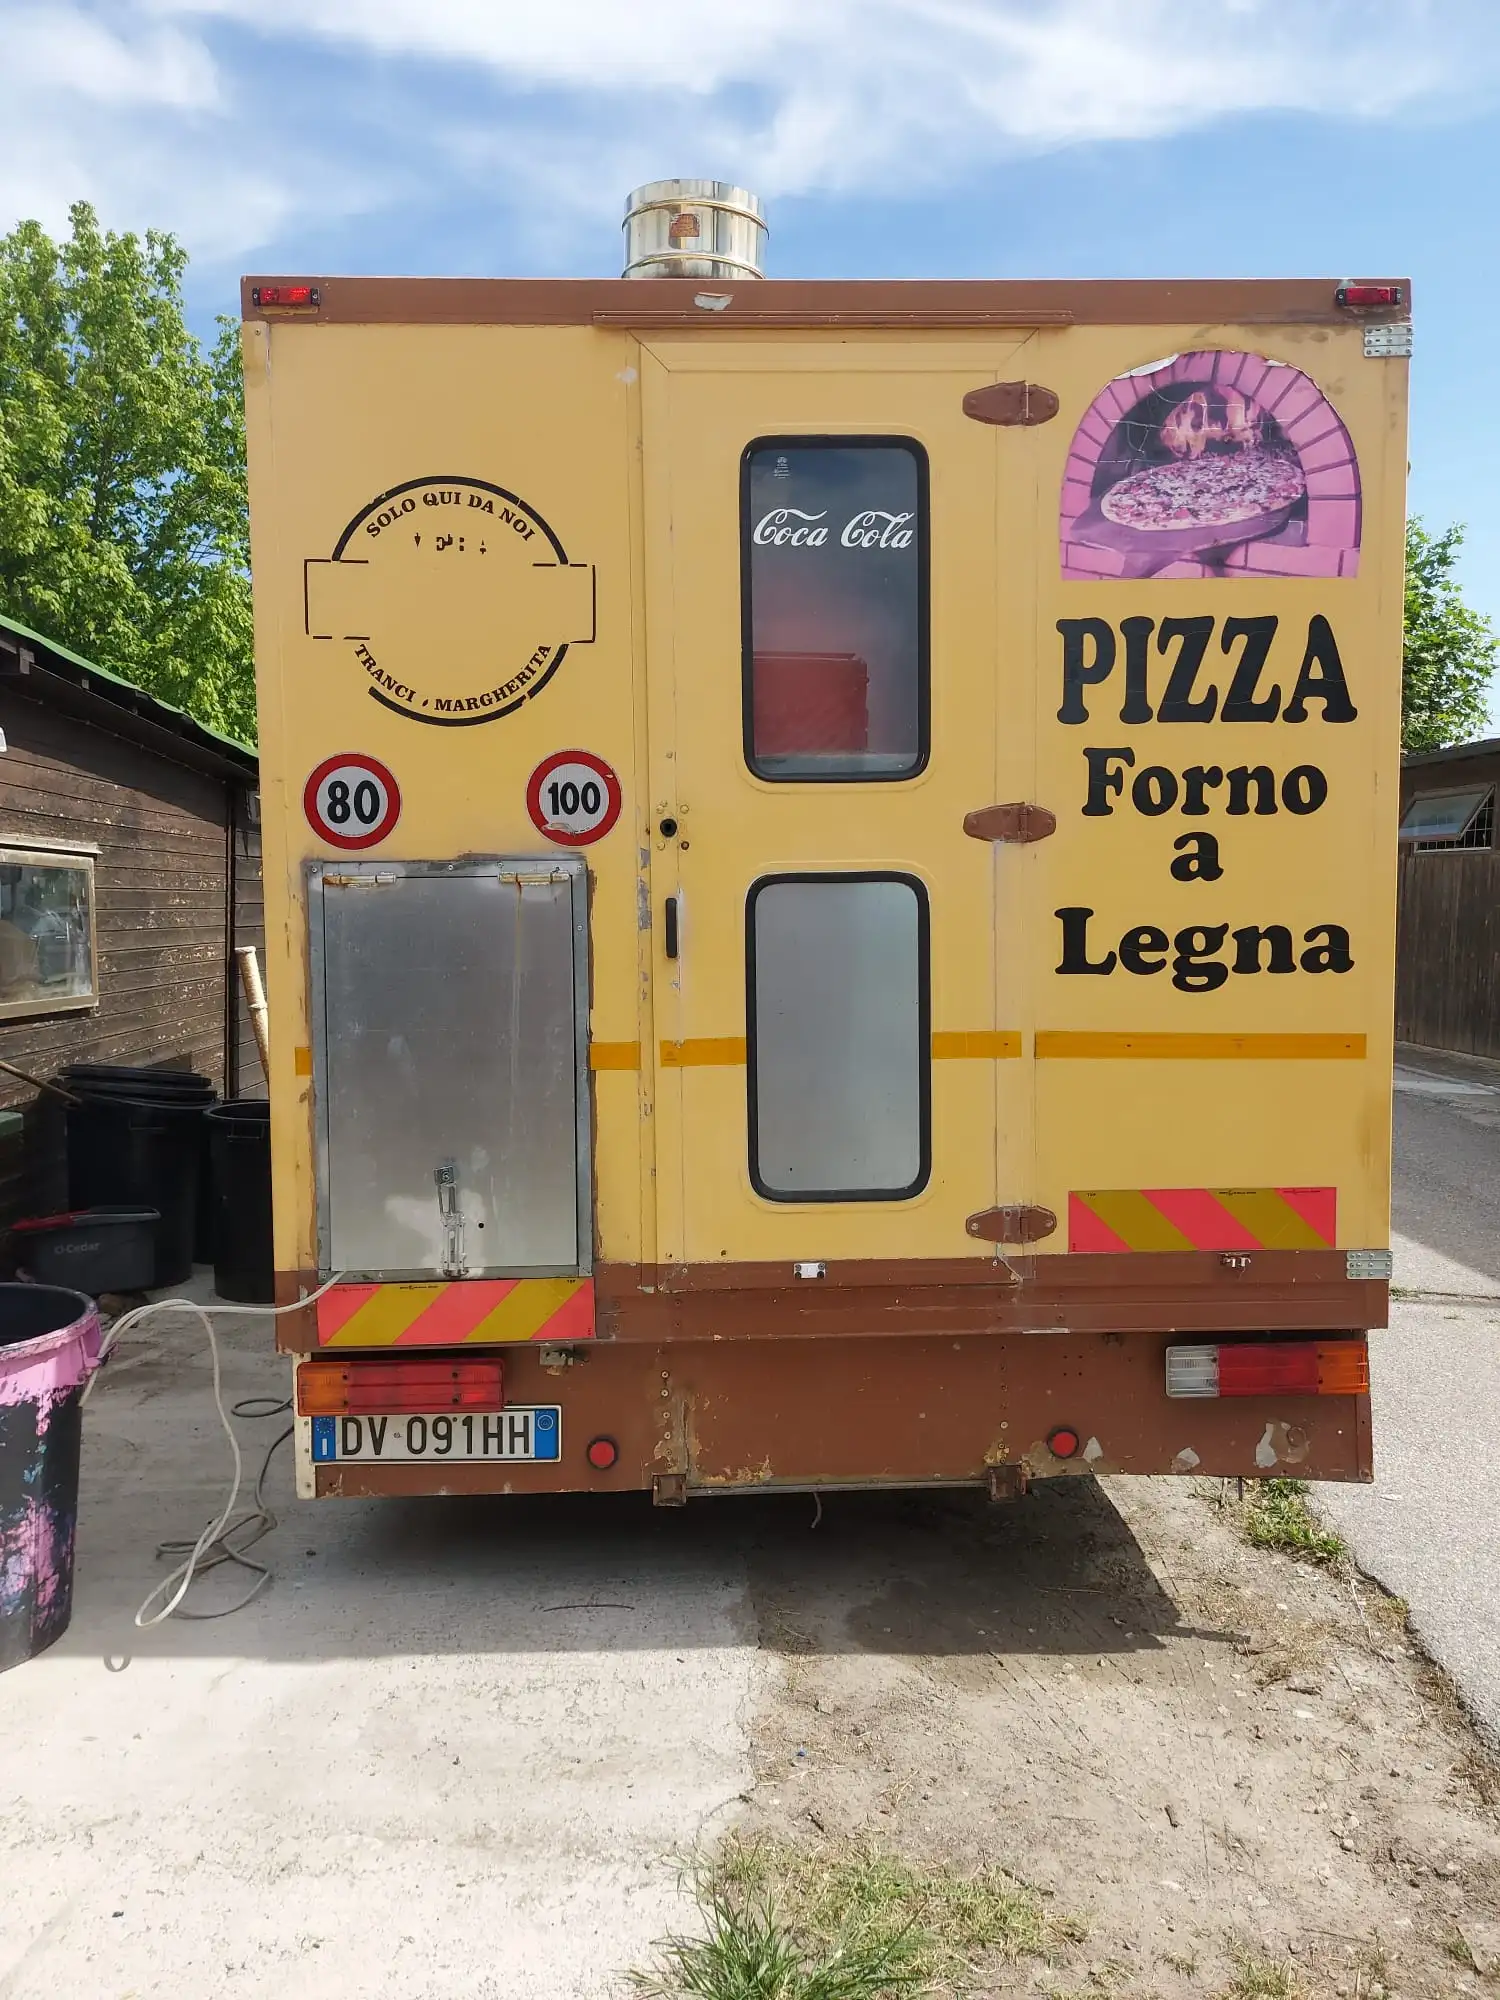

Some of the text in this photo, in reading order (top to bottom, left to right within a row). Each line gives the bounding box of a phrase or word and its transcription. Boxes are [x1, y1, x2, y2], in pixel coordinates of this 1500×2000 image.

[366, 491, 536, 542] SOLO QUI DA NOI
[753, 508, 915, 549] Coca Cola
[354, 644, 551, 712] TRANCI MARGHERITA
[1056, 614, 1358, 725] PIZZA
[327, 780, 380, 824] 80
[547, 781, 600, 815] 100
[1081, 746, 1328, 816] Forno
[1170, 831, 1224, 882] a
[1054, 907, 1355, 993] Legna
[341, 1415, 388, 1456] DV
